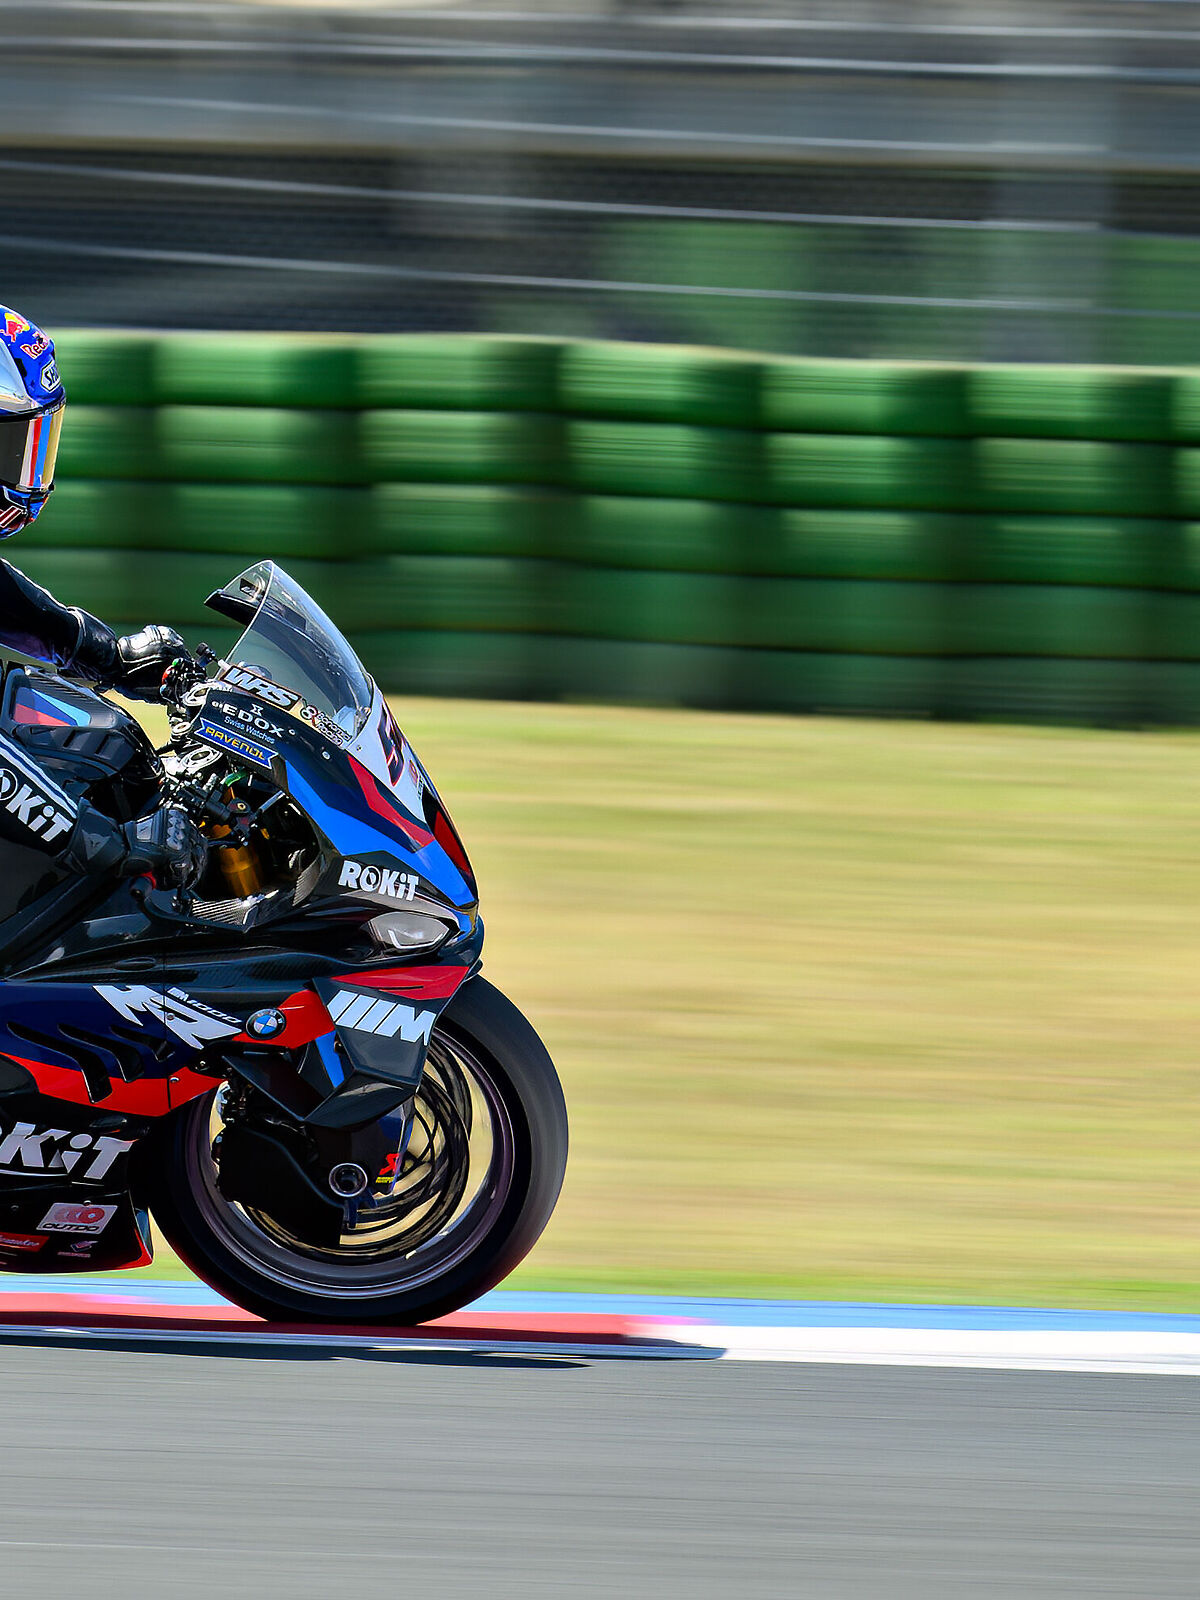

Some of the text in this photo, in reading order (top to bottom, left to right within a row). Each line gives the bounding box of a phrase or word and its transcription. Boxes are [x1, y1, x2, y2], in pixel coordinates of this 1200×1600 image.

[224, 668, 299, 707] WRS
[222, 703, 284, 738] EDOX
[246, 725, 275, 745] Watches
[205, 726, 265, 760] RAVENOL
[338, 860, 420, 901] ROKiT
[43, 1222, 100, 1232] OUTDO
